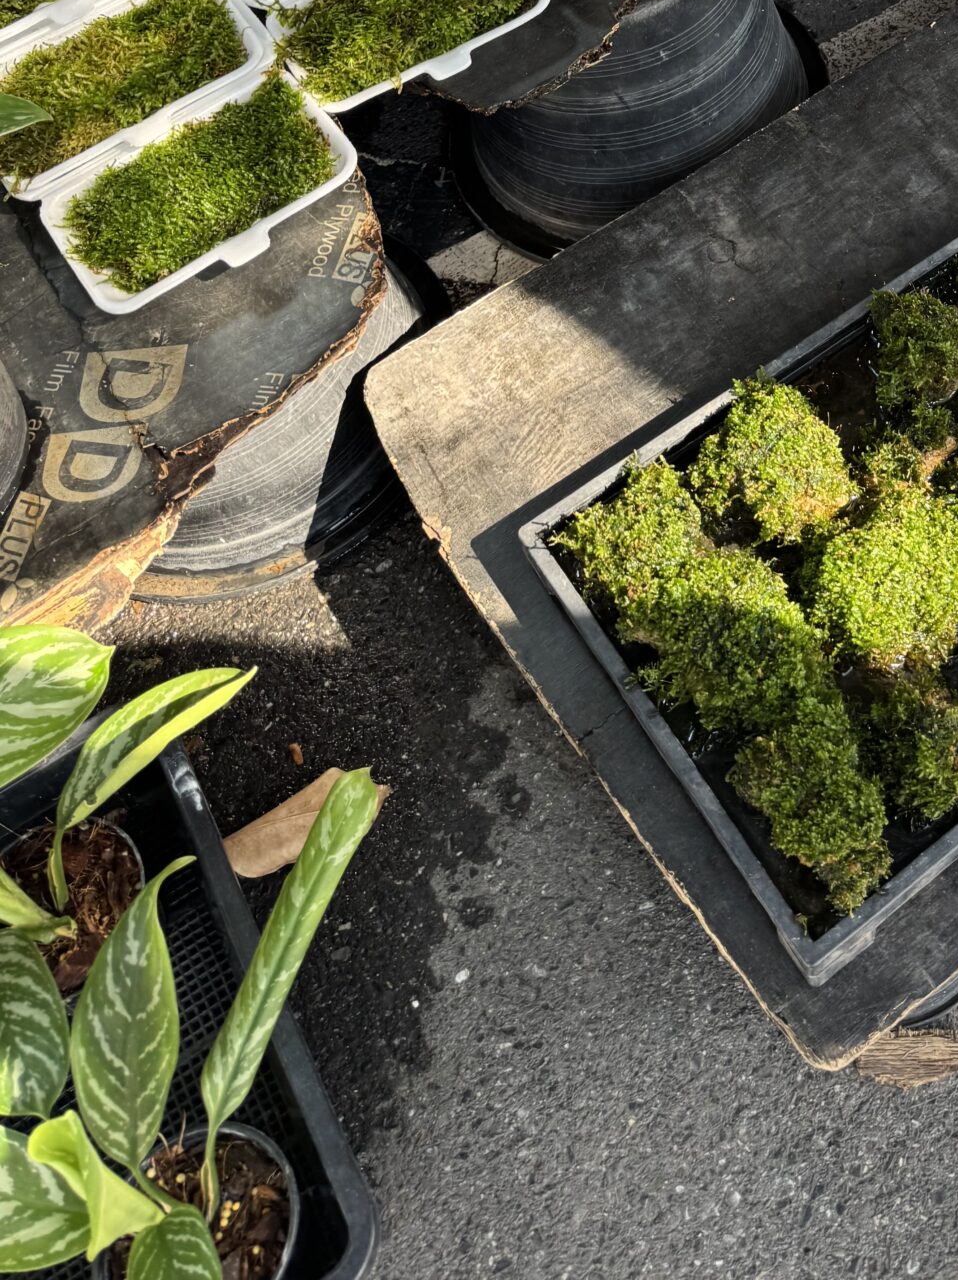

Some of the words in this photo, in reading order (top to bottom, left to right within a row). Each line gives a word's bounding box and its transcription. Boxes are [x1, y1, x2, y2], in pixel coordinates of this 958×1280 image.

[307, 204, 354, 278] Plywood
[43, 350, 81, 392] Film
[248, 372, 284, 412] Film
[0, 495, 48, 578] PLUS
